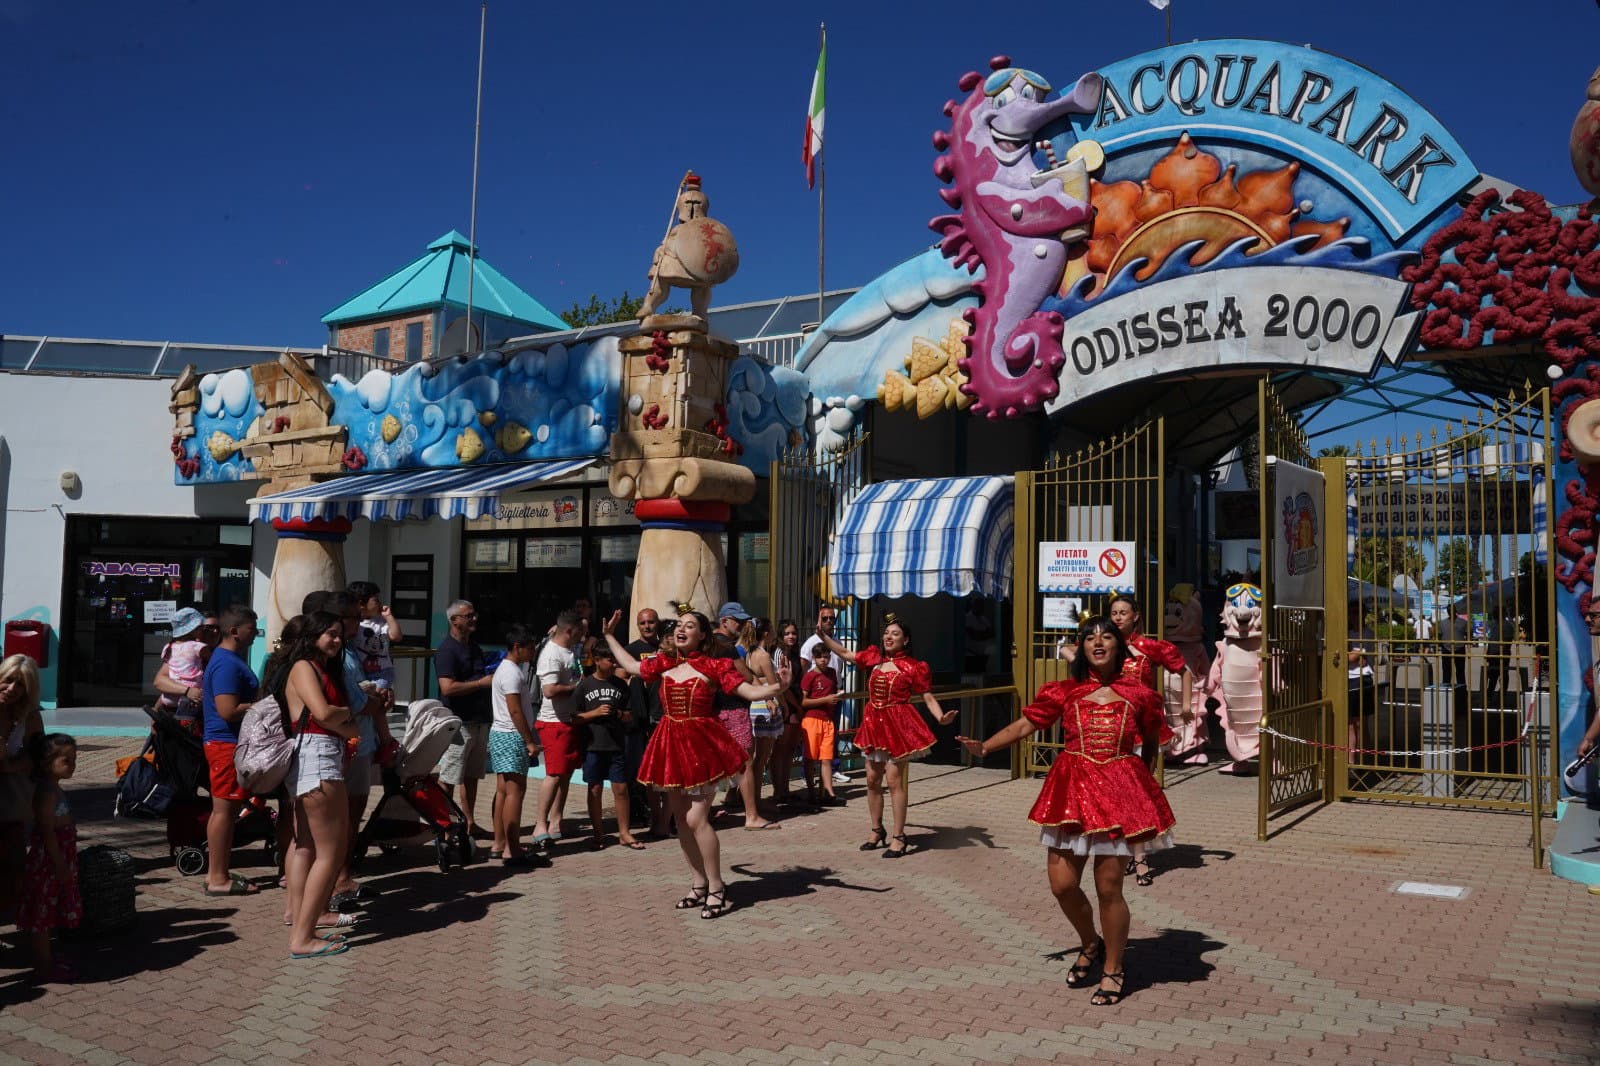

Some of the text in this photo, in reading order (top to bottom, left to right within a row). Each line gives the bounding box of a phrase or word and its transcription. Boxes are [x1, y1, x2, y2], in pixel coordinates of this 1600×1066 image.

[1094, 53, 1457, 205] ACQUAPARK
[1071, 293, 1381, 375] ODISSEA 2000
[1359, 491, 1379, 506] ark
[1382, 491, 1433, 505] Odissea
[496, 504, 550, 523] Biglietteria
[1056, 549, 1088, 558] VIETATO
[82, 561, 180, 577] TABACCHI
[585, 690, 599, 701] YOU
